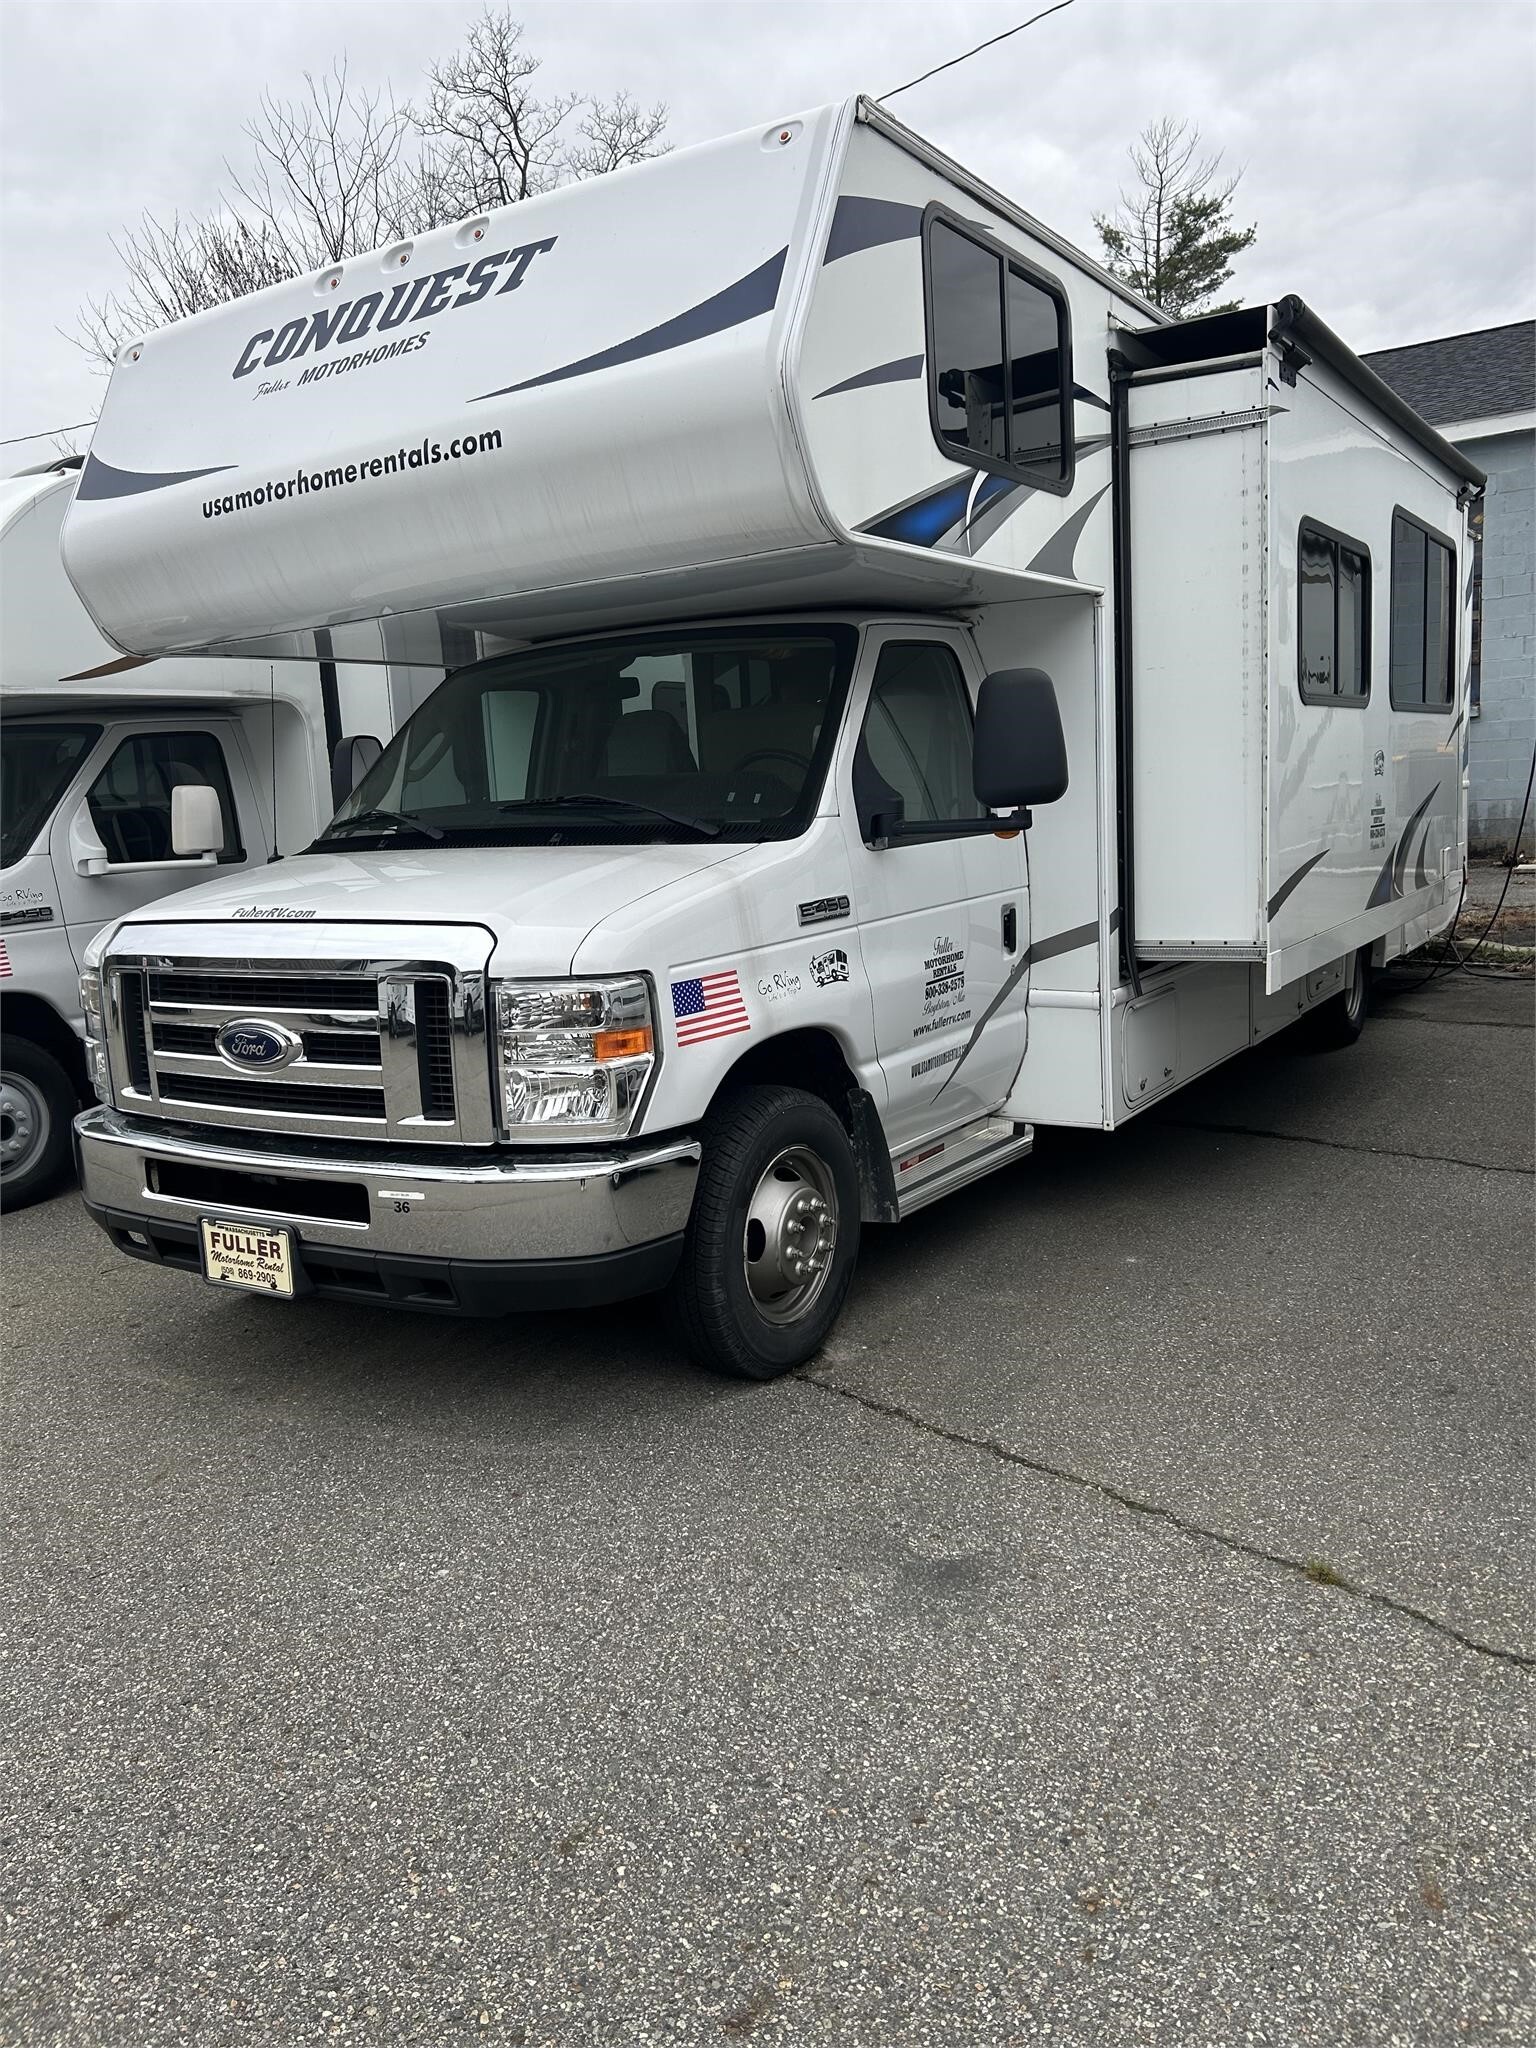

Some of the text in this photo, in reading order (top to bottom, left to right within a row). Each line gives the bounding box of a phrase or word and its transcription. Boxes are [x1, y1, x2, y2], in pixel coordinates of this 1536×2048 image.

[232, 236, 558, 379] CONQUEST
[297, 331, 431, 386] MOTORHOMES
[202, 429, 503, 518] usamotorhomerentals.com
[231, 906, 317, 918] FullerRV.com
[924, 950, 964, 970] MOTORHOME
[932, 963, 957, 979] RENTALS
[757, 979, 773, 996] Go
[772, 970, 802, 990] RVing
[913, 1009, 971, 1037] www.fullerrv.com
[231, 1033, 267, 1056] Ford
[393, 1201, 410, 1213] 36
[224, 1226, 266, 1238] MASSACHUSETTS
[210, 1231, 282, 1260] FULLER
[210, 1249, 285, 1273] Motorhome Rental
[238, 1268, 277, 1284] 869-2905
